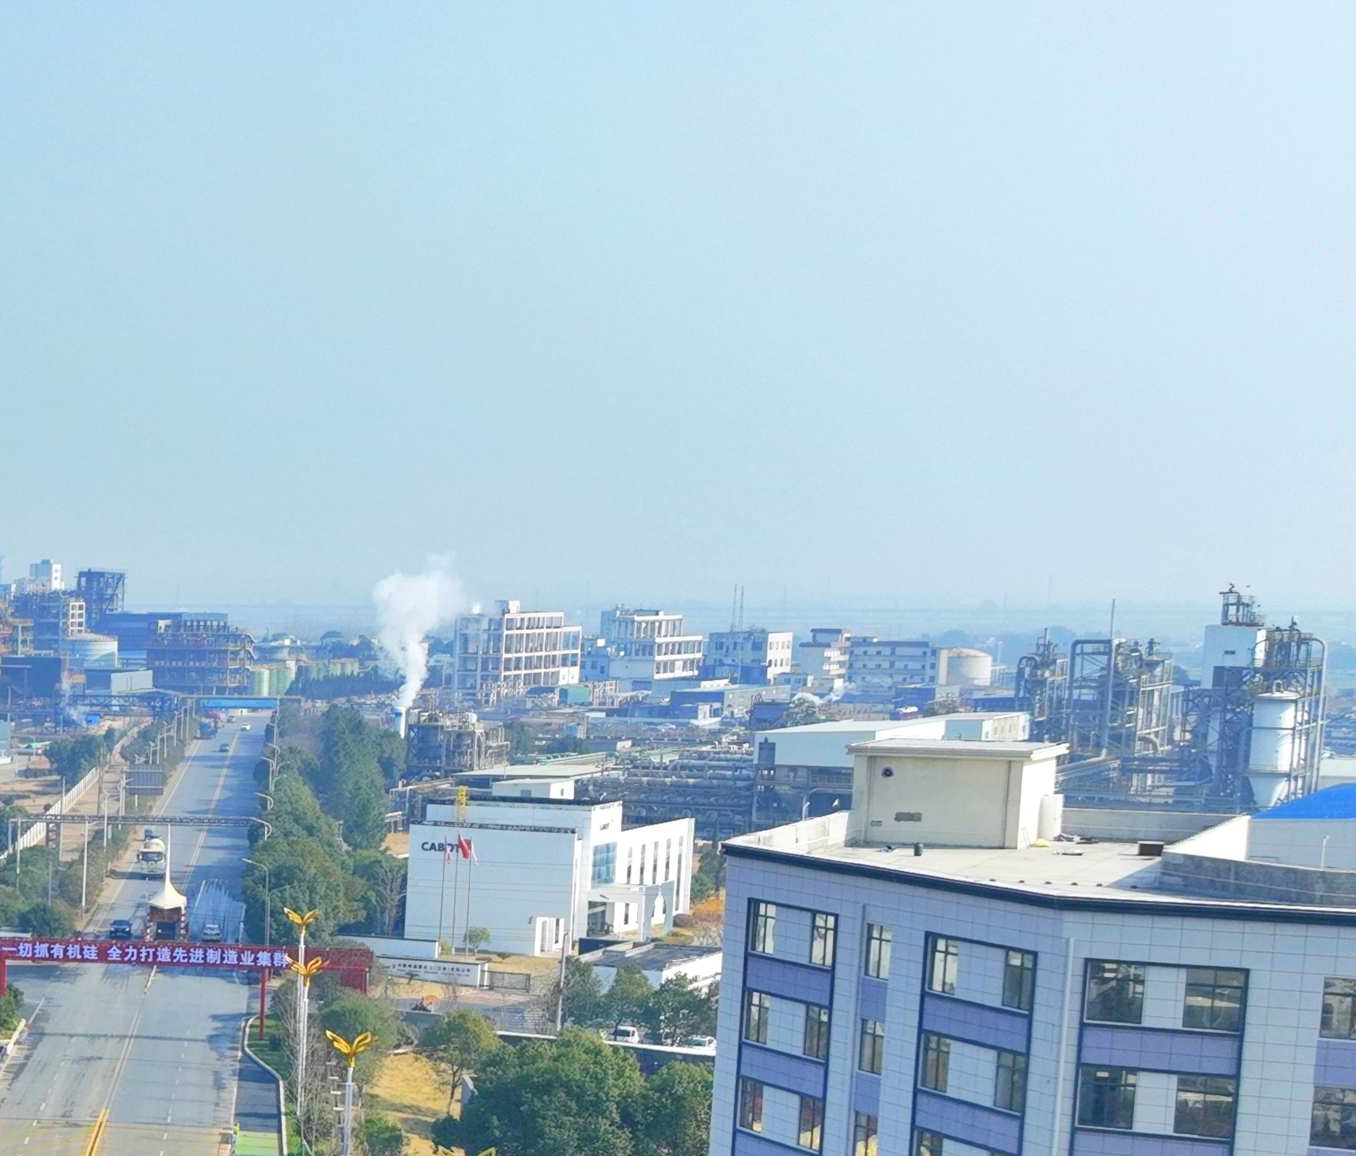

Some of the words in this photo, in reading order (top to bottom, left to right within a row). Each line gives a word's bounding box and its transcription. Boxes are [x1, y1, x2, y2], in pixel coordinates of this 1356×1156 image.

[106, 944, 289, 968] 全力打造先进制造业集群
